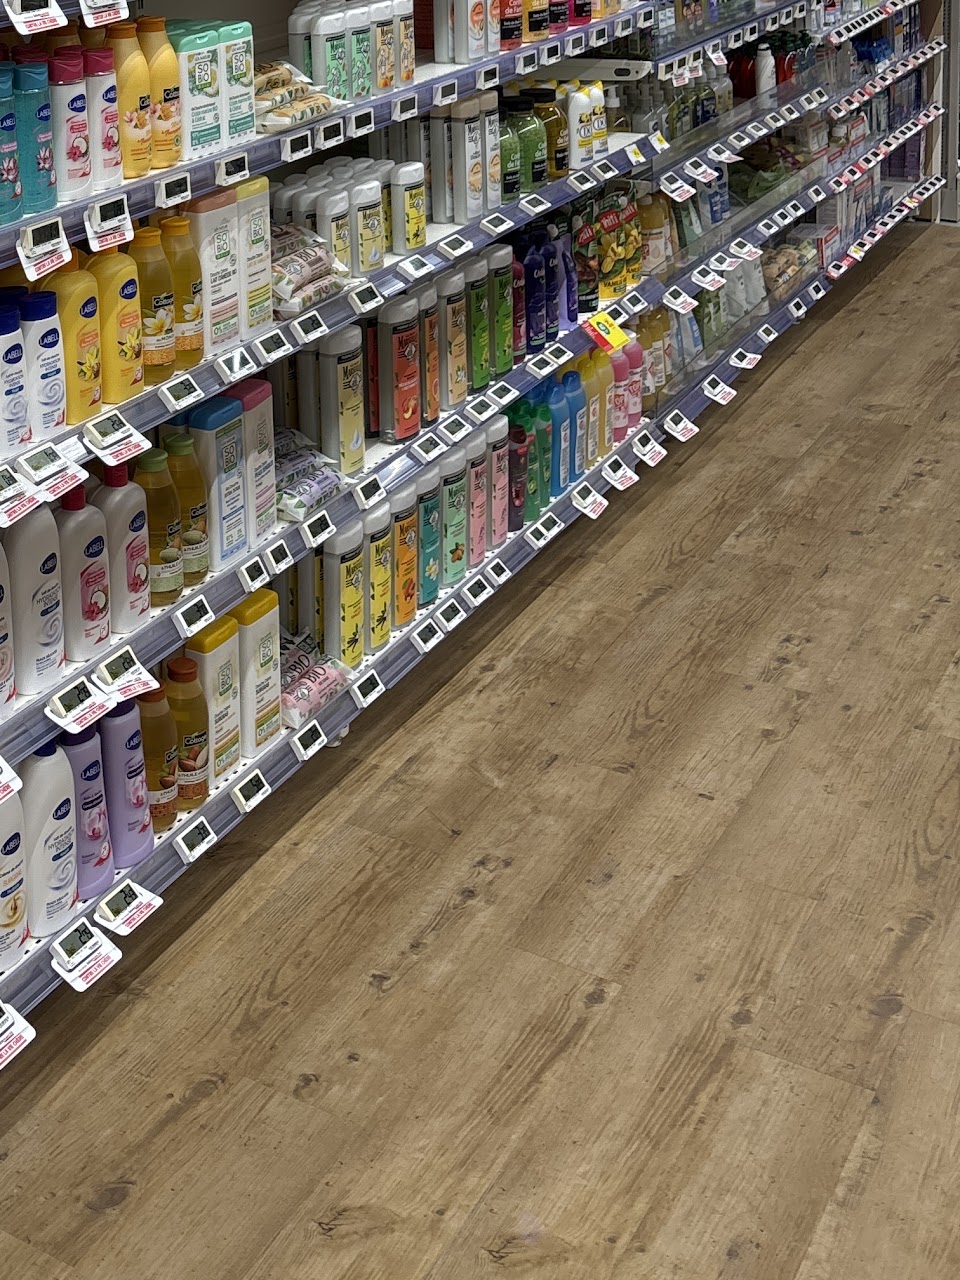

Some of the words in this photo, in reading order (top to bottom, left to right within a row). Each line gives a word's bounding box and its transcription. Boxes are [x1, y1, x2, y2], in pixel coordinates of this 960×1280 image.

[120, 283, 137, 297] LABELL
[80, 302, 97, 315] LABELL
[38, 334, 59, 346] LABELL
[3, 349, 22, 362] LABELL
[80, 764, 101, 780] LABELL
[53, 802, 71, 819] LABELL
[1, 837, 21, 854] LABELL
